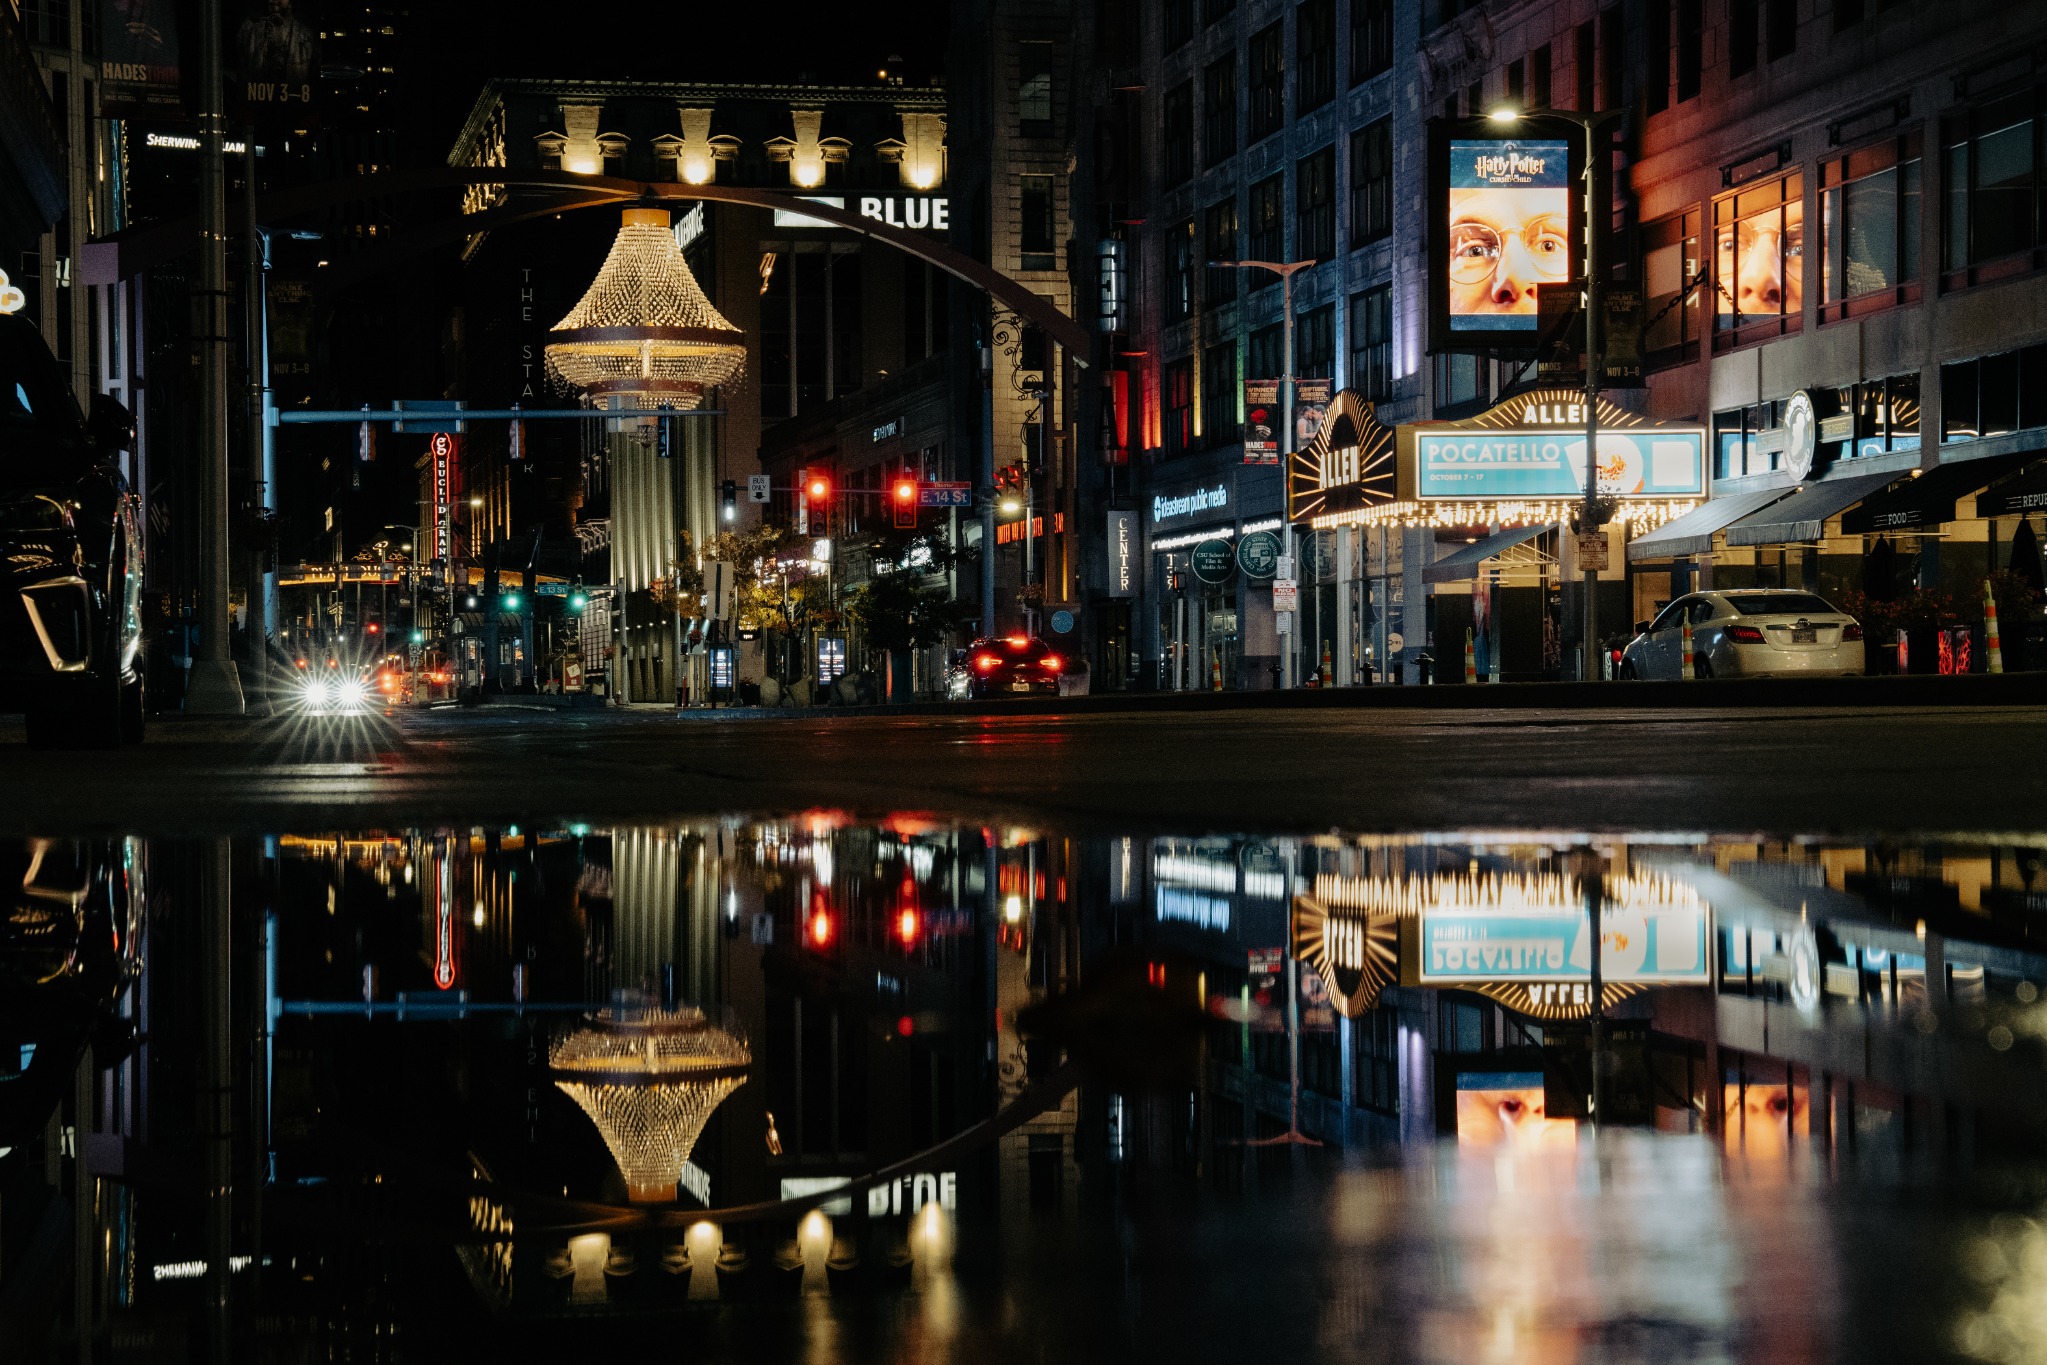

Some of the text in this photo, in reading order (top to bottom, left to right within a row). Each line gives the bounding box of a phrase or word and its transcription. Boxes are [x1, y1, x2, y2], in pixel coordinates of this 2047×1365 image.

[247, 82, 275, 102] NOV
[1475, 153, 1545, 178] Harry Potter
[521, 268, 533, 322] THE
[274, 362, 289, 375] NOV
[1607, 367, 1621, 377] NOV
[1524, 405, 1588, 423] ALLE
[1428, 443, 1561, 463] POCATELLO
[1319, 446, 1360, 489] ALLEN
[1430, 473, 1462, 481] OCTOBER
[1464, 473, 1469, 481] 7
[1476, 473, 1484, 481] 17
[751, 484, 768, 492] ONLY
[935, 490, 950, 503] 14
[952, 490, 968, 503] St
[1190, 488, 1208, 517] public
[1208, 484, 1227, 508] media
[1888, 512, 1907, 525] FOOD
[1119, 517, 1130, 591] CENTER
